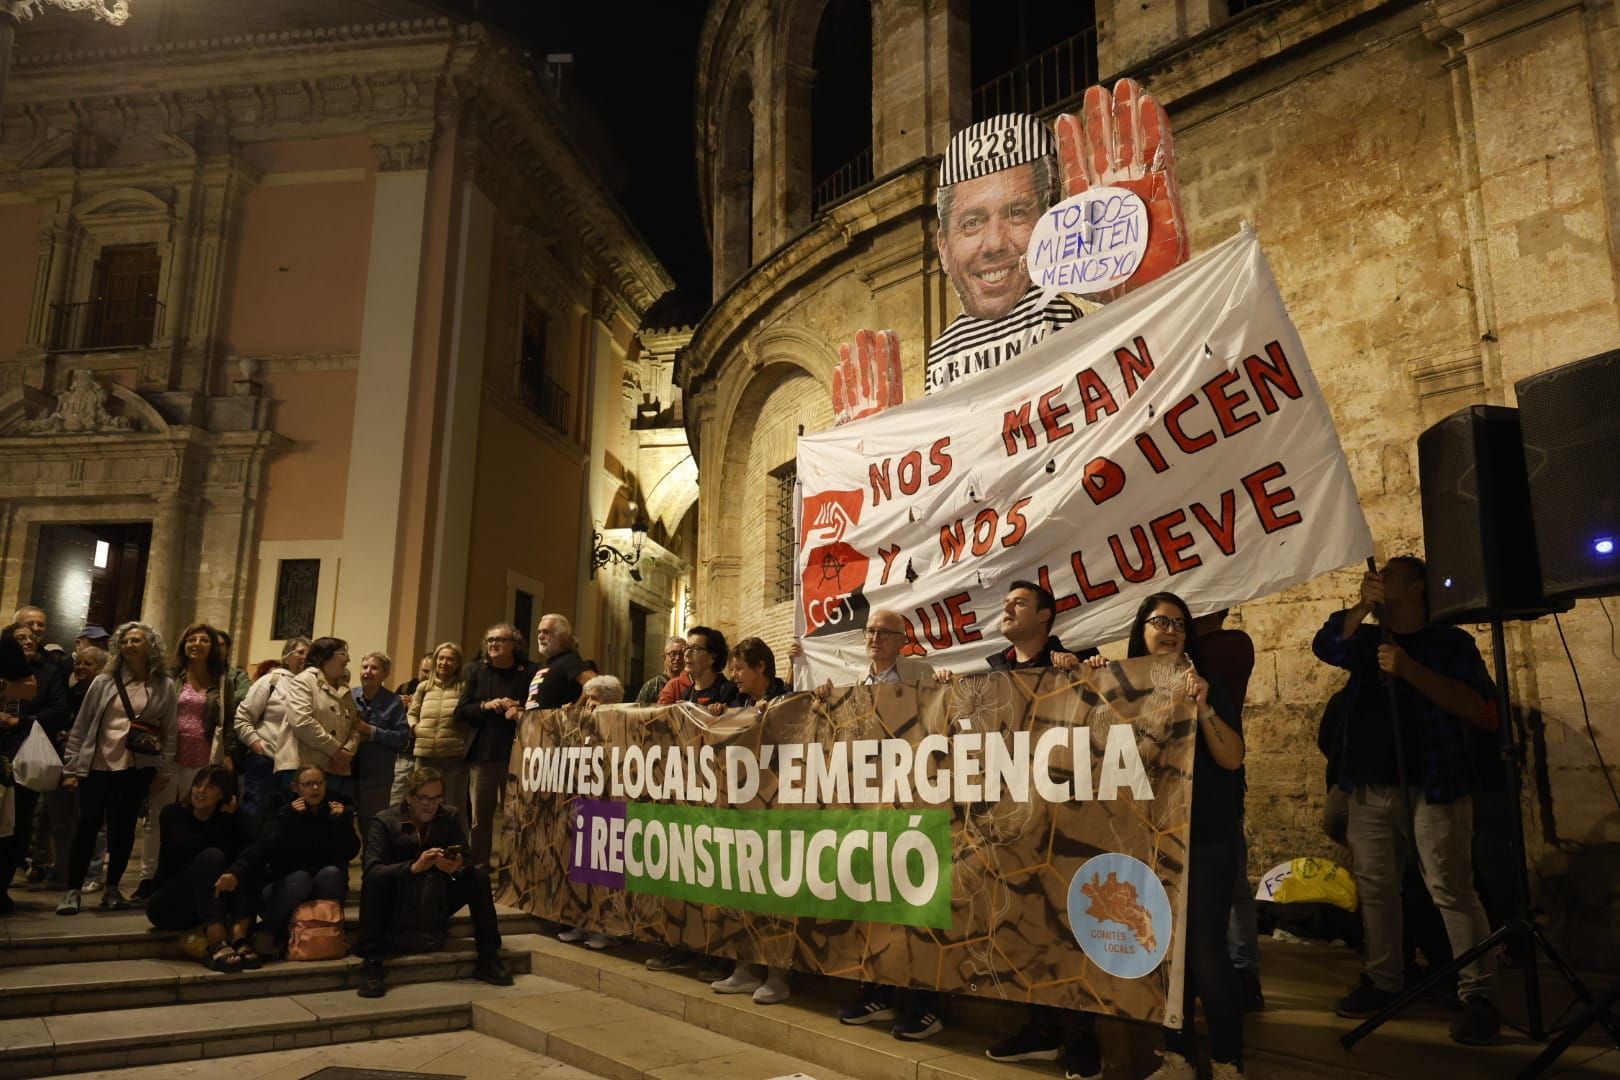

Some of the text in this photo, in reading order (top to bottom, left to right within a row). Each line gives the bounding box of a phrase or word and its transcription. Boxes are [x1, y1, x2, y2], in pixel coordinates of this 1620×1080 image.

[971, 127, 1016, 163] 228
[1050, 194, 1139, 232] TODOS
[1035, 215, 1139, 265] MIENTEN
[868, 336, 1156, 507] NOS MEAN
[878, 339, 1303, 585] Y NOS DICEN
[1038, 461, 1303, 613] LLUEVE
[808, 592, 855, 630] CGT
[521, 736, 605, 796] COMITÉS
[611, 744, 718, 804] LOCALS
[726, 719, 1154, 804] D'EMERGÈNCIA
[590, 814, 940, 907] RECONSTRUCCIÓ
[1091, 929, 1127, 942] COMITÉS
[1104, 944, 1136, 955] LOCALS
